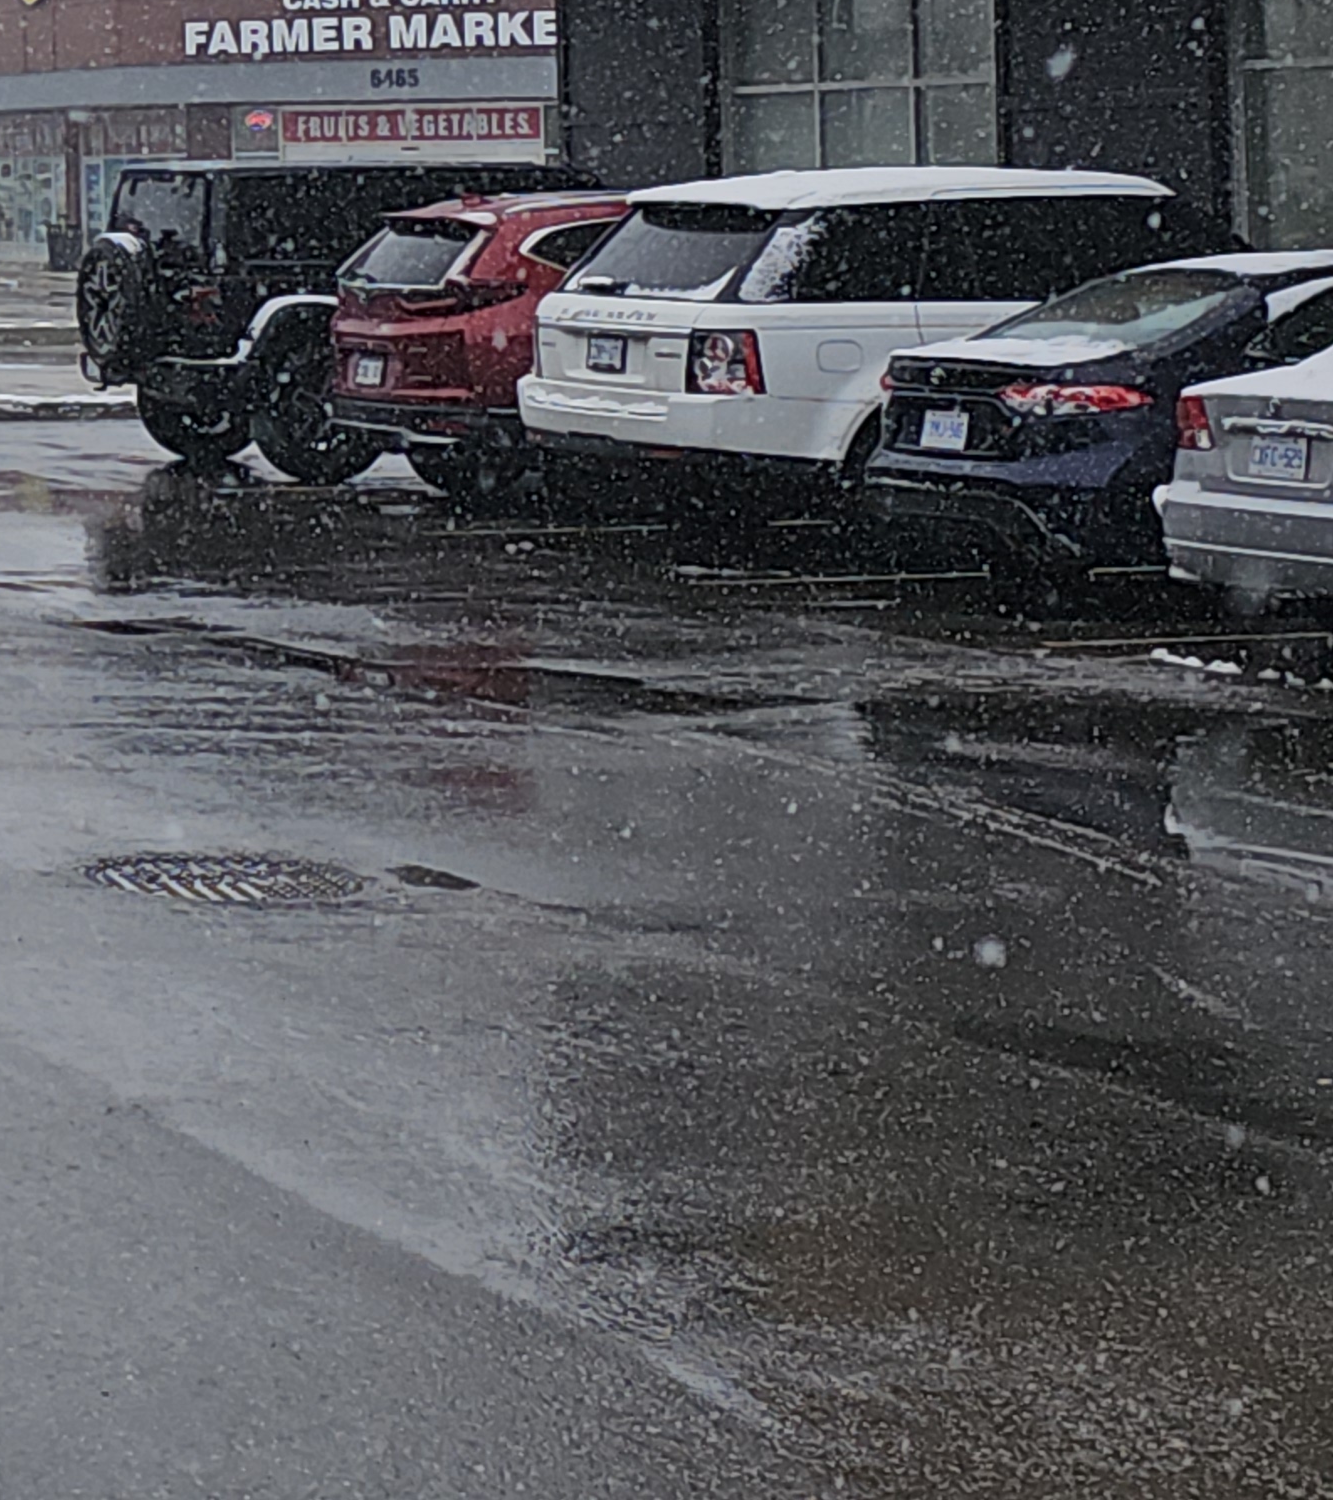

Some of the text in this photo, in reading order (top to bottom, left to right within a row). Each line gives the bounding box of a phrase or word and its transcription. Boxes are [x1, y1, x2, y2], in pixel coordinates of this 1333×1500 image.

[184, 10, 557, 56] FARMER MARKE
[370, 67, 421, 89] 6465
[297, 114, 370, 138] FRUITS
[376, 114, 392, 137] &
[397, 111, 533, 137] VEGETABLES
